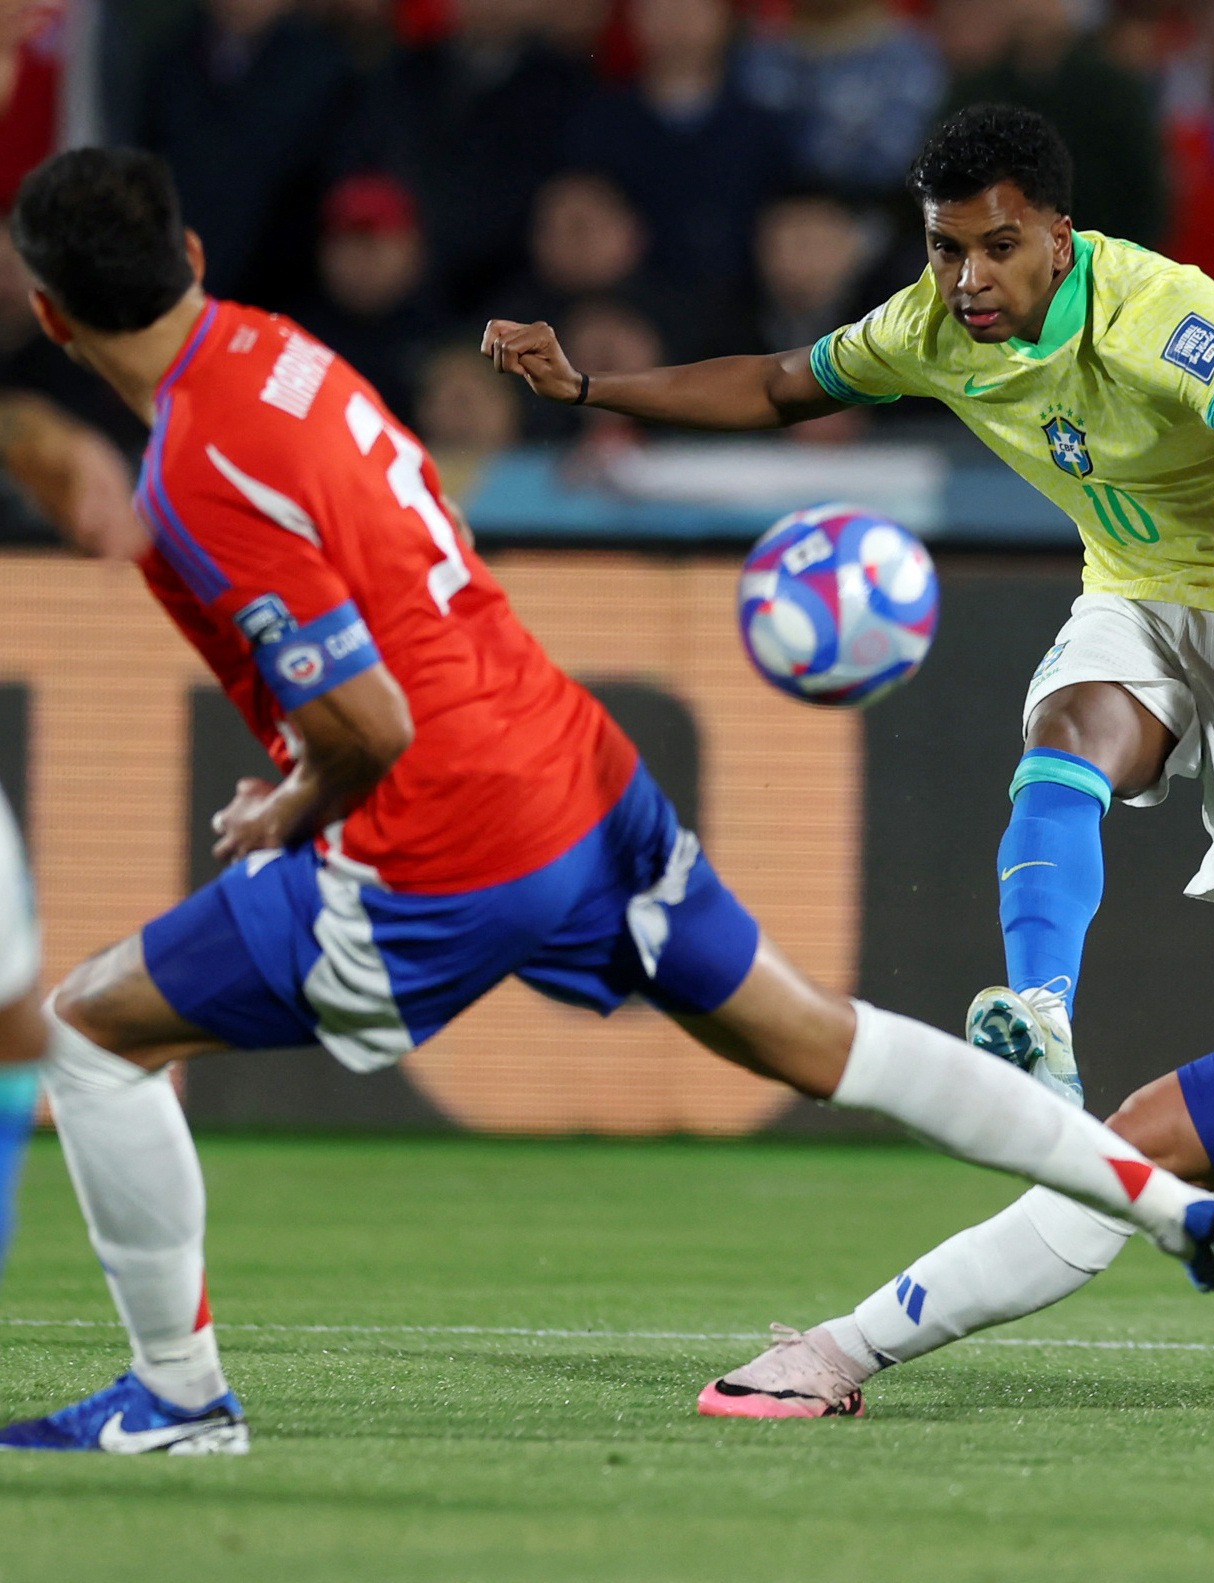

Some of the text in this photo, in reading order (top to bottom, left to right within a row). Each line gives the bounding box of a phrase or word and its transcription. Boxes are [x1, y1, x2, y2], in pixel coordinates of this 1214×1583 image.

[1174, 324, 1199, 353] FOOTBALL
[1181, 327, 1207, 357] UNITES
[1058, 442, 1075, 453] CBF
[1082, 484, 1160, 546] 10
